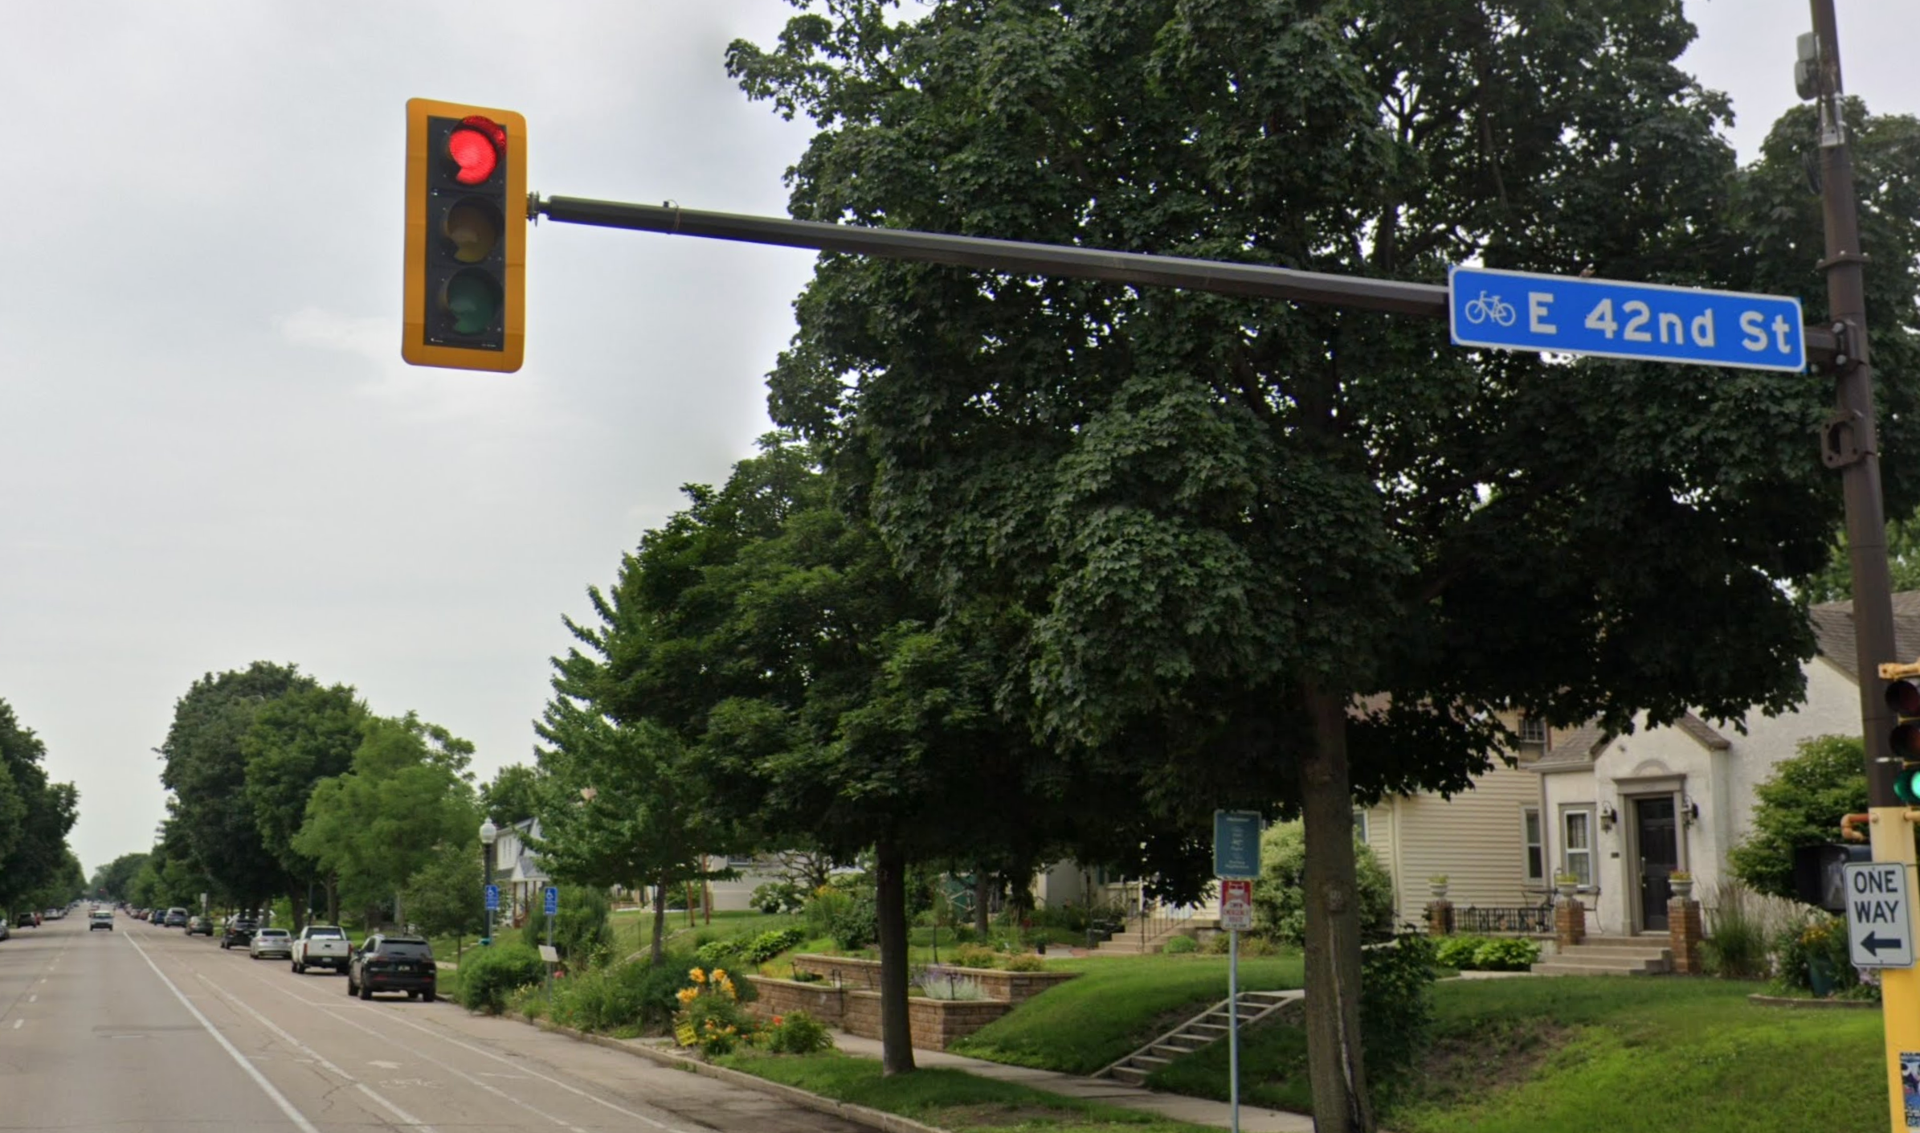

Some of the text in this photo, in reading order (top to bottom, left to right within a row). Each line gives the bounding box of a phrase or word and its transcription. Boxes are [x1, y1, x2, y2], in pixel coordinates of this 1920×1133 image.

[1529, 292, 1790, 353] E 42nd St
[1854, 870, 1898, 894] ONE
[1854, 900, 1899, 924] WAY
